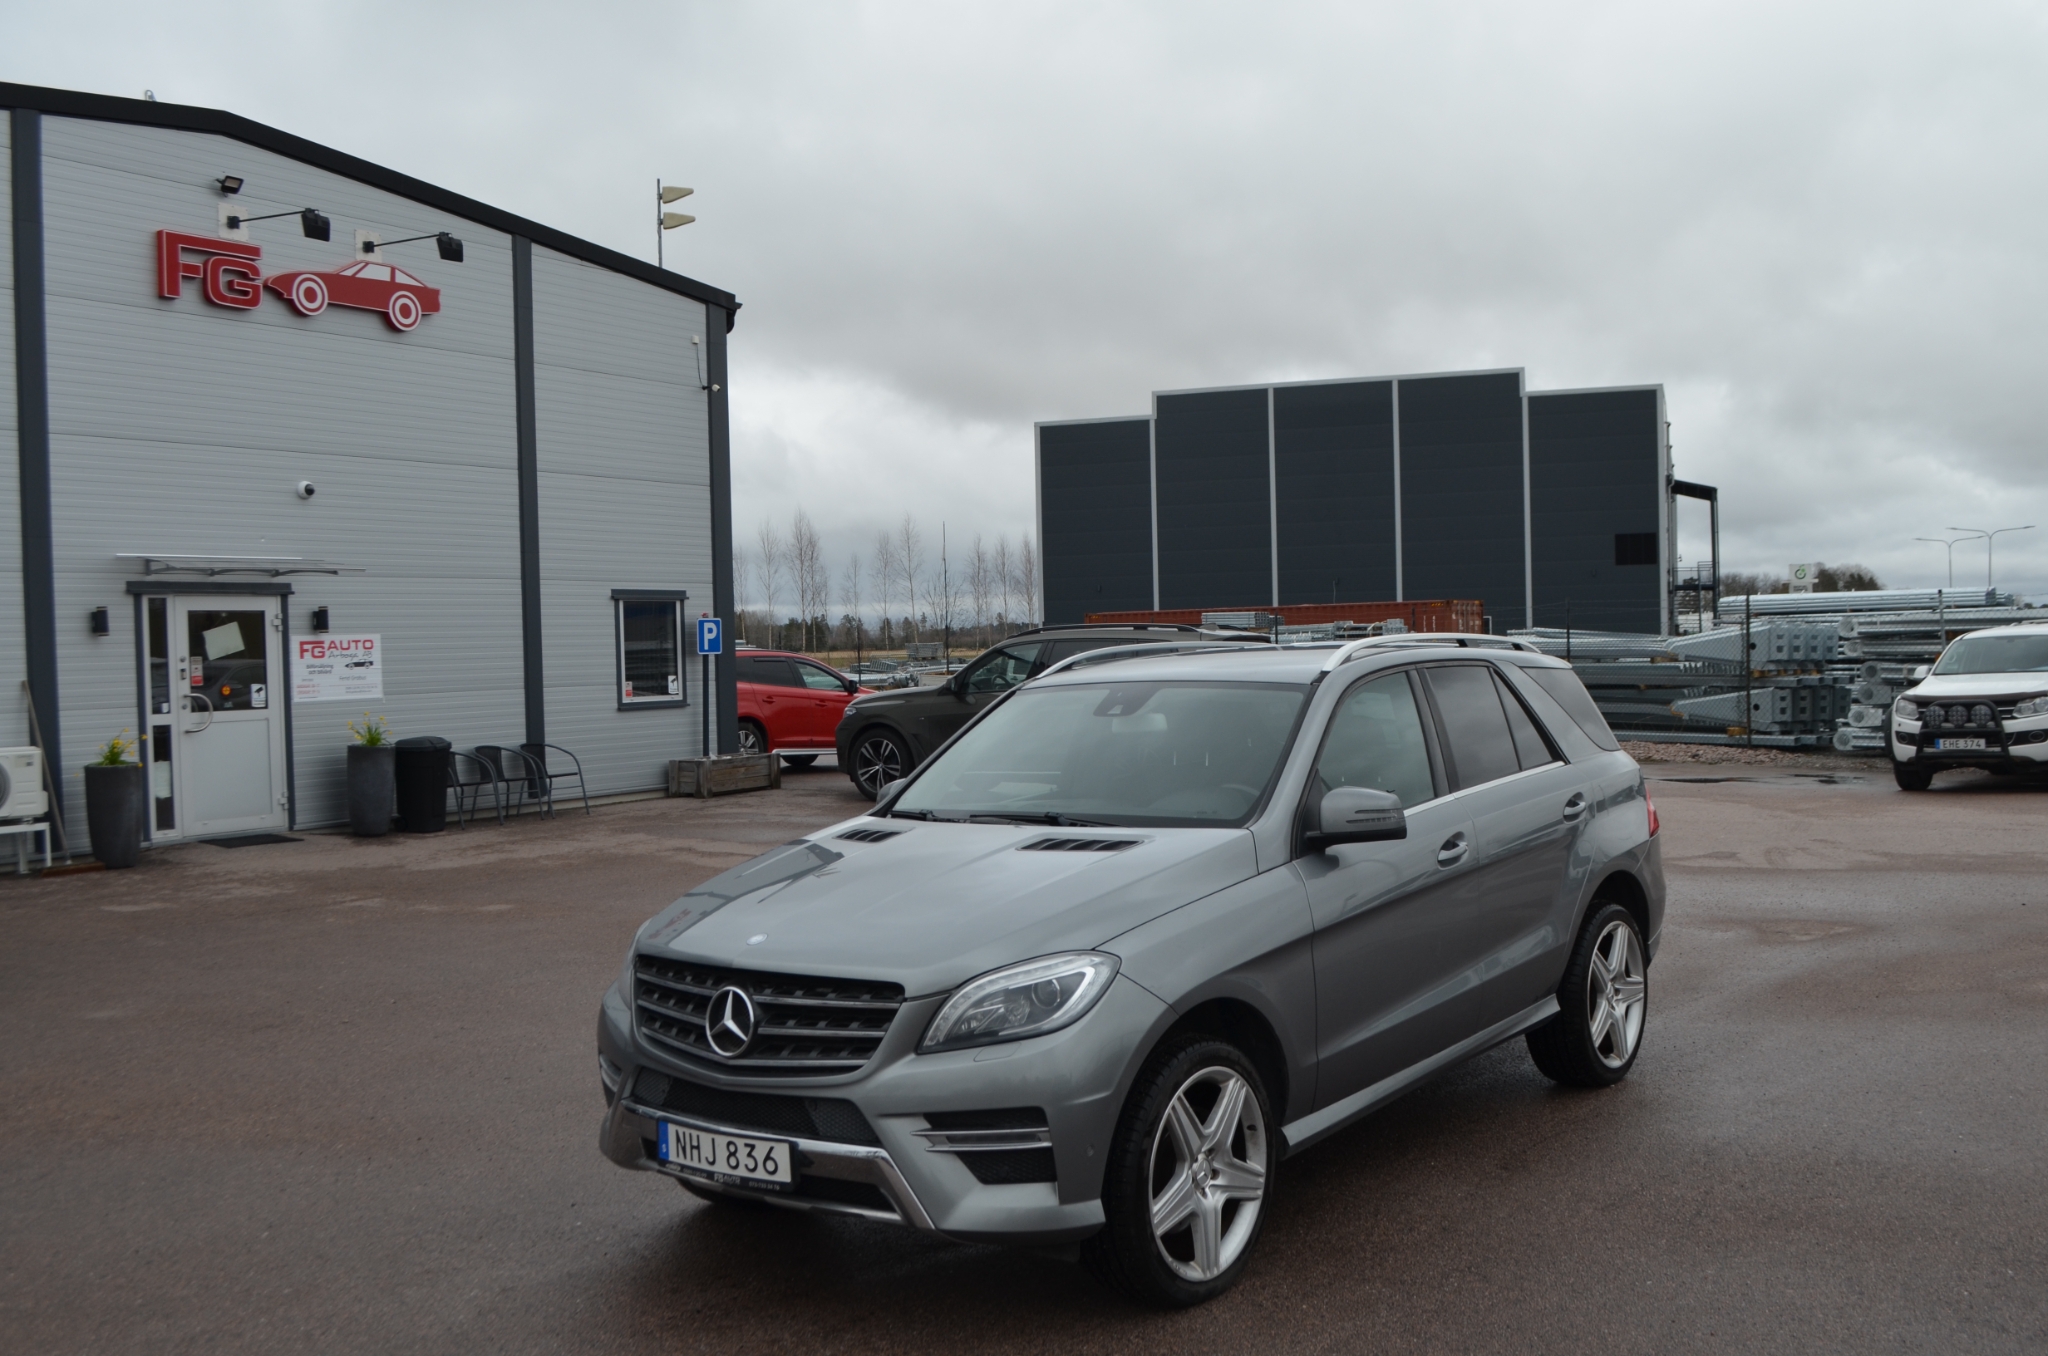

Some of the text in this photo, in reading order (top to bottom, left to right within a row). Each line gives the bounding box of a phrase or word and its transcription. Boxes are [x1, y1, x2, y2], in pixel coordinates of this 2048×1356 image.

[158, 229, 263, 309] FG
[299, 639, 374, 659] FG AUTO
[703, 622, 718, 650] P
[1942, 740, 1981, 748] EHE 374
[675, 1128, 778, 1175] NHJ 836
